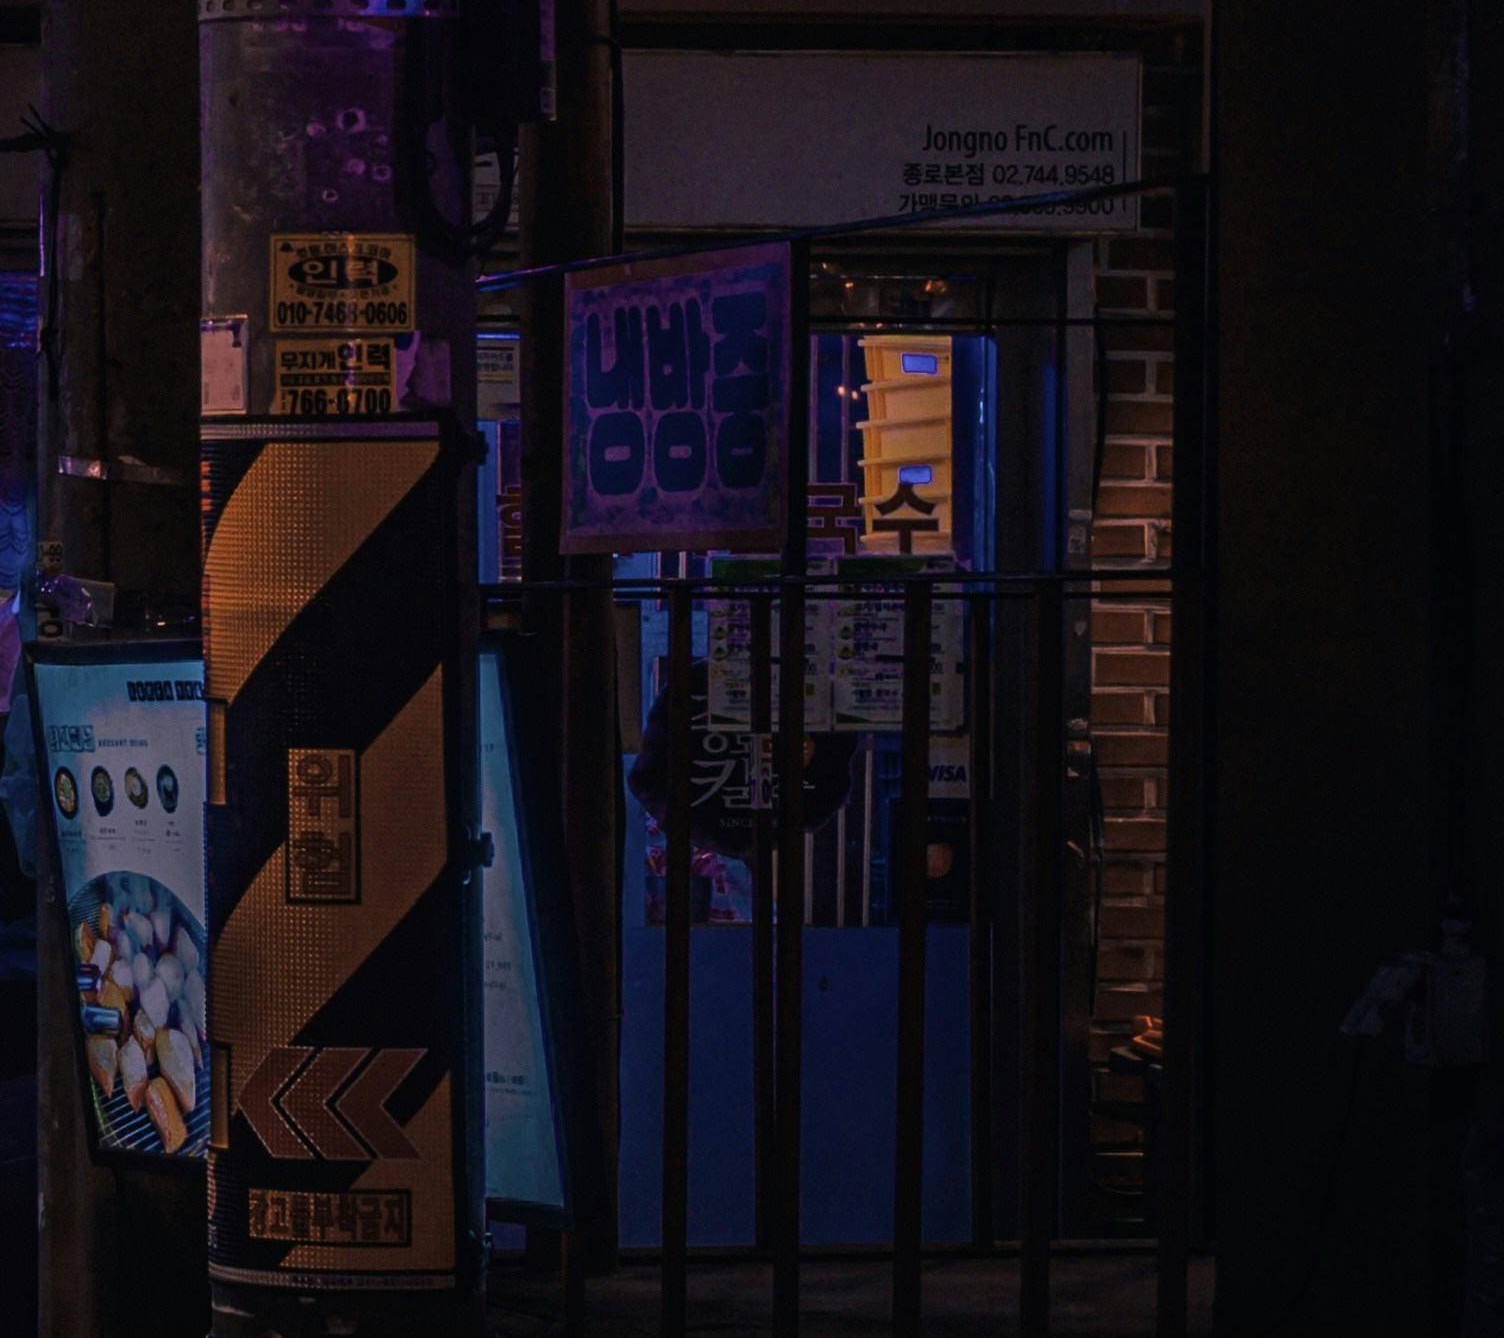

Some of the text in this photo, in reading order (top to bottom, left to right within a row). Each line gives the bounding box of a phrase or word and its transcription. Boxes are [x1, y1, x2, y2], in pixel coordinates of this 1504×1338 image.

[922, 124, 1114, 158] Jongno FnC.com
[902, 163, 1116, 187] 종로본점 02.744.9548
[301, 260, 380, 286] 인력
[587, 290, 771, 496] 냉방중
[292, 753, 353, 896] 위험
